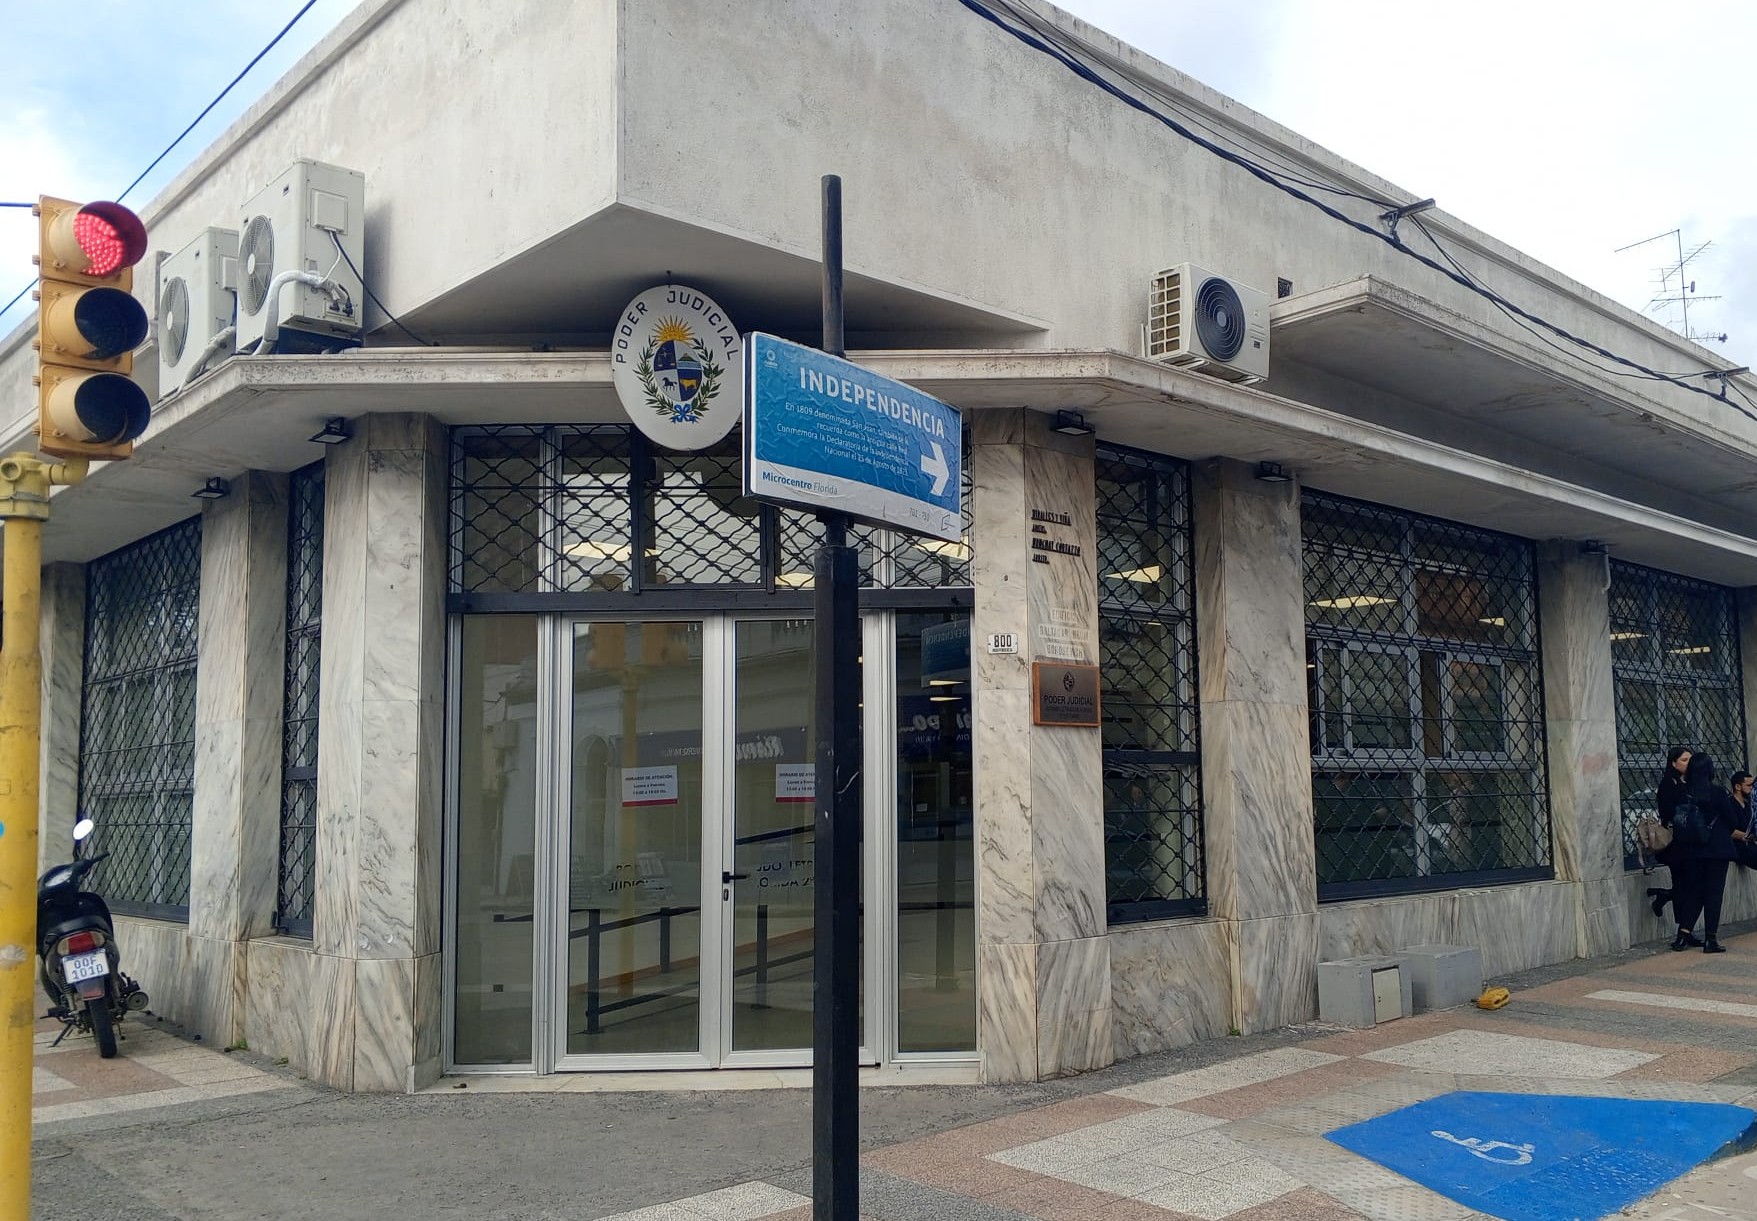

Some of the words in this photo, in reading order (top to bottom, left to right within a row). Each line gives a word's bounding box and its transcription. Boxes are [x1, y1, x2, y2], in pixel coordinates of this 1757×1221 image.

[616, 301, 648, 363] PODER
[667, 290, 738, 360] JUDICIAL
[800, 366, 945, 439] INDEPENDENCIA
[785, 401, 795, 411] En
[796, 404, 813, 416] 1809
[814, 408, 851, 426] denominada
[852, 419, 862, 430] San
[777, 423, 818, 440] Conmemora
[819, 432, 826, 441] la
[826, 434, 861, 451] Declaratoria
[816, 422, 843, 435] recuerda
[844, 429, 860, 439] como
[824, 445, 851, 459] Nacional
[762, 471, 812, 490] Microcentro
[813, 482, 838, 495] Florida
[994, 634, 1012, 648] 800
[1043, 695, 1066, 705] PODER
[1067, 696, 1093, 706] JUDICIAL
